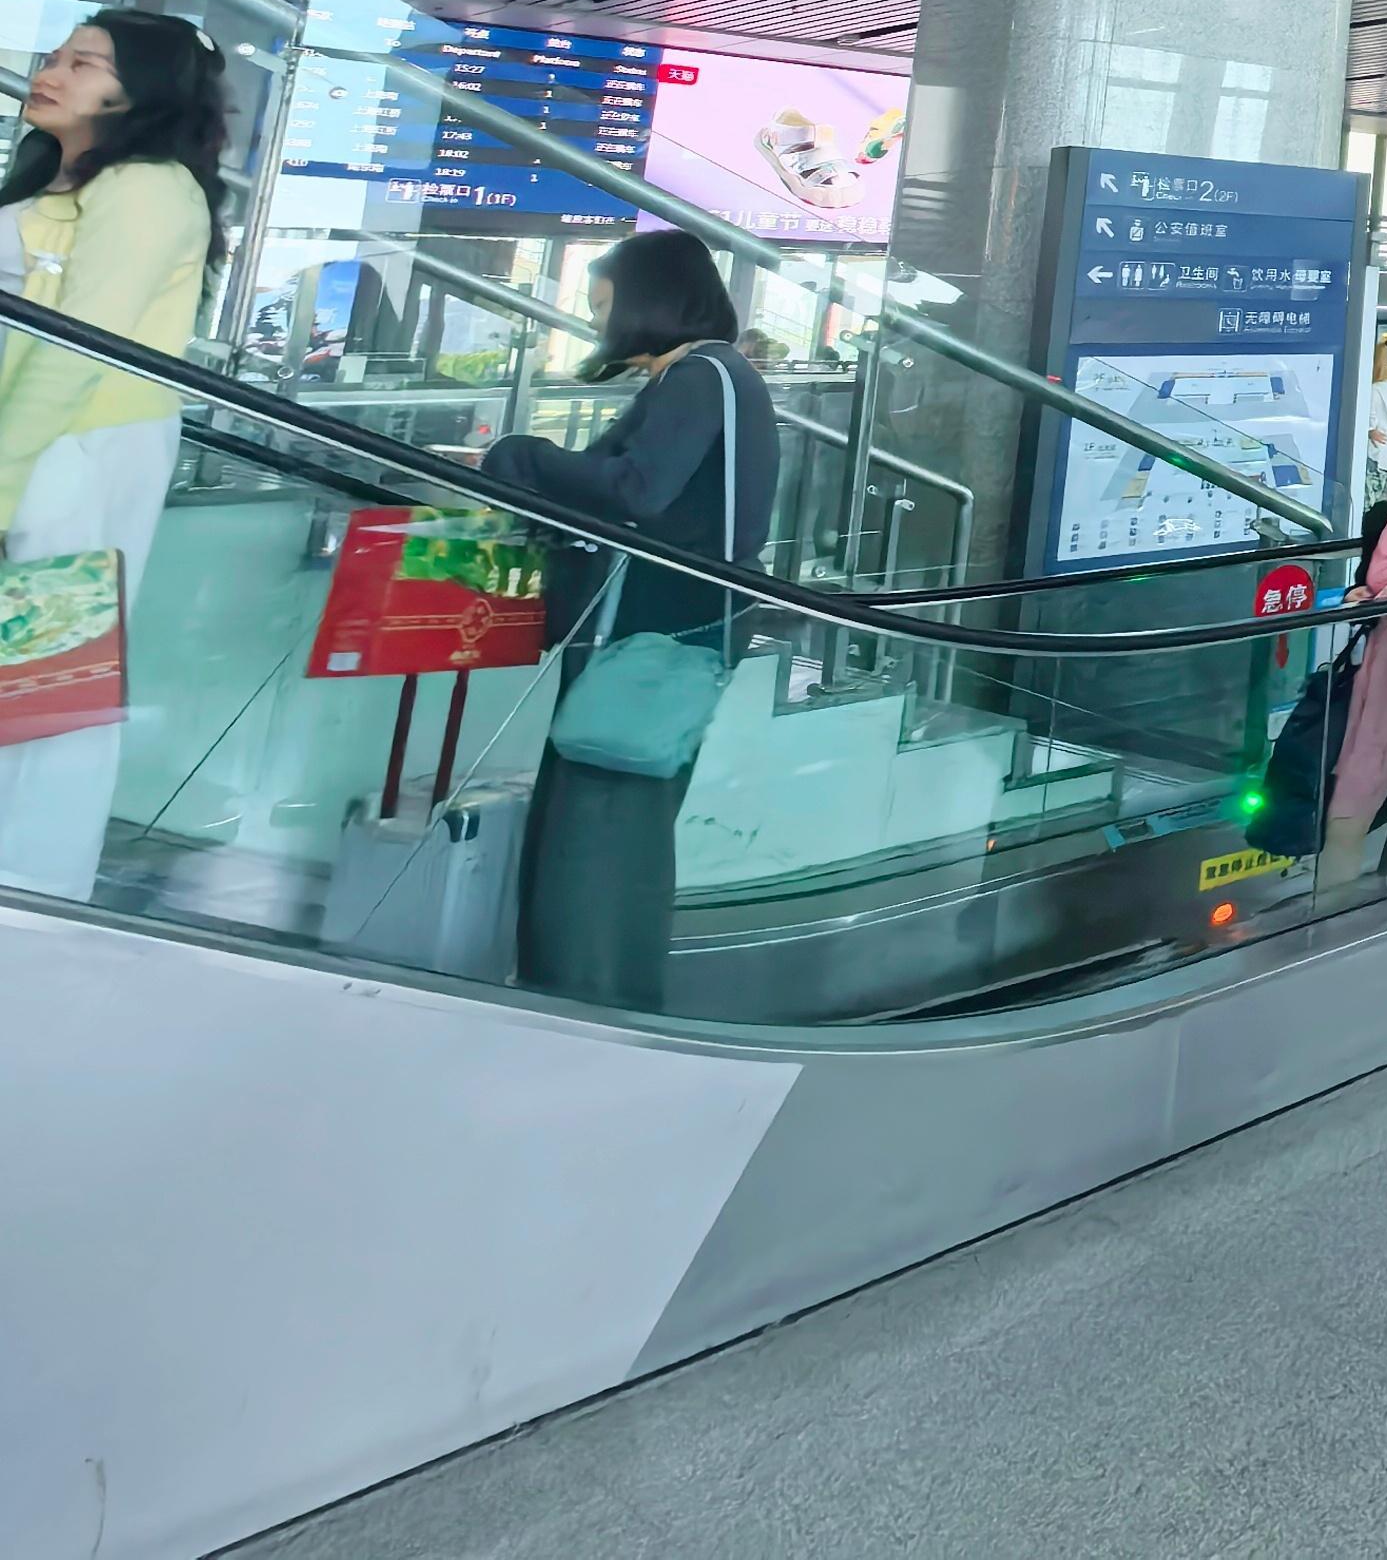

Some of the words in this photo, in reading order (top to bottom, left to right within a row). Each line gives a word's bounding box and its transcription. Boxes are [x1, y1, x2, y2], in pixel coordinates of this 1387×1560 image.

[422, 183, 471, 197] 检票口
[708, 209, 799, 230] 1儿童节
[1155, 221, 1228, 237] 公安值班室
[1178, 266, 1219, 281] 卫生间
[1252, 269, 1291, 282] 饮用水
[1245, 312, 1311, 325] 无障碍电梯
[1261, 584, 1308, 613] 急停
